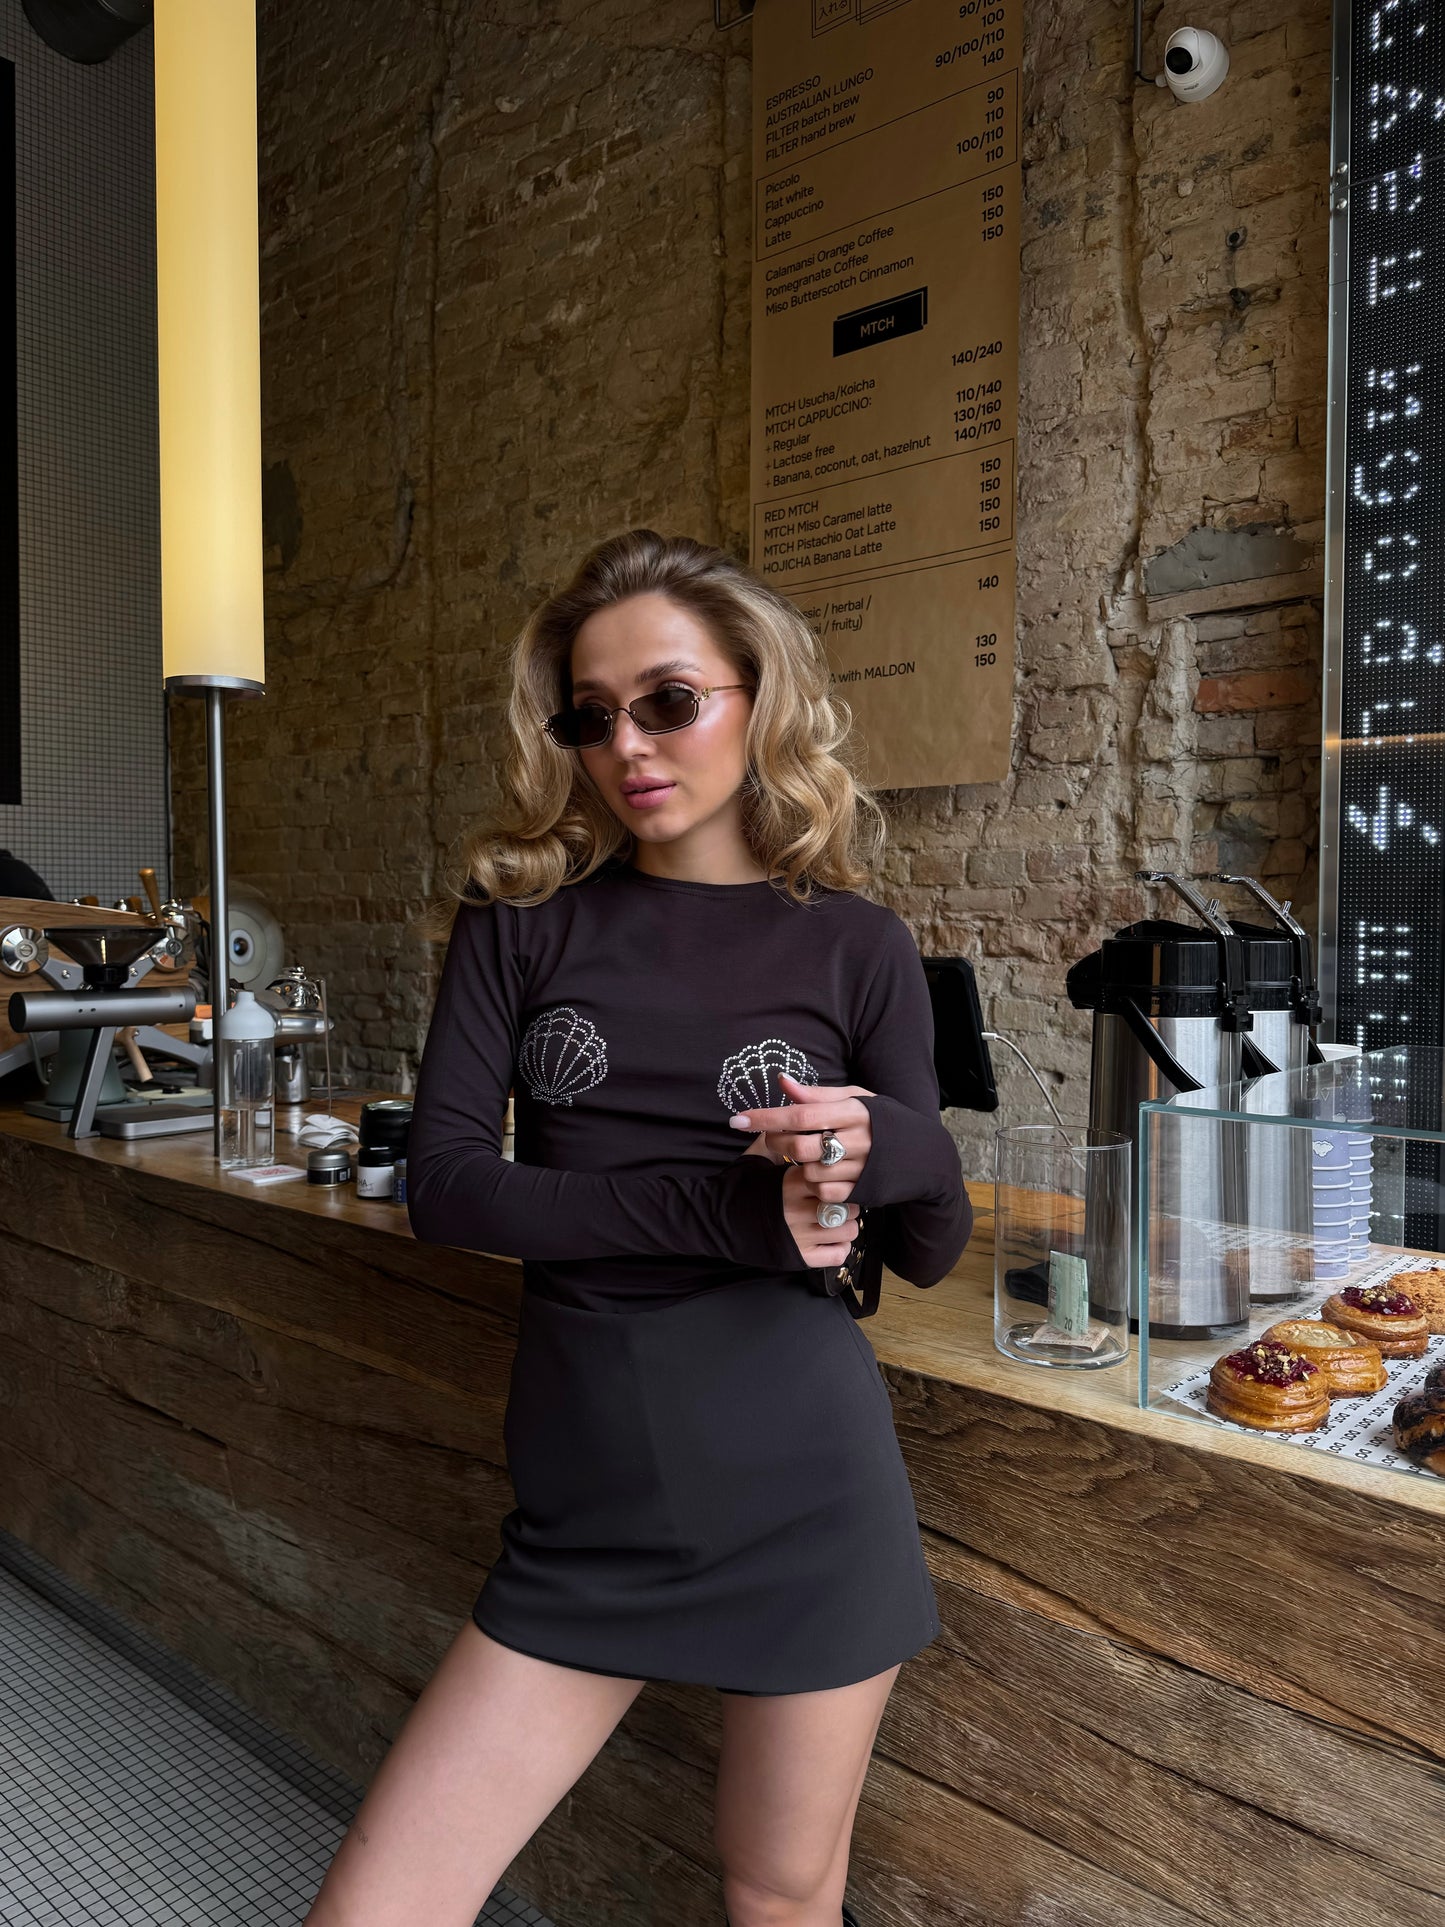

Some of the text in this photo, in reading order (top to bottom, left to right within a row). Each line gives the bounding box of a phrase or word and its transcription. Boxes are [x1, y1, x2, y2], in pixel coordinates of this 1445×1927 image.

[960, 0, 1003, 19] 90/10
[982, 8, 1004, 27] 100
[935, 28, 1004, 68] 90/100/110
[982, 48, 1004, 67] 140
[766, 75, 820, 110] ESPRESSO
[766, 68, 874, 128] AUSTRALIAN LUNGO
[987, 87, 1004, 104] 90
[766, 94, 860, 145] FILTER batch brew
[985, 106, 1004, 124] 110
[766, 114, 856, 162] FILTER hand brew
[956, 126, 1004, 155] 100/110
[985, 145, 1004, 163] 110
[765, 174, 800, 196] Piccolo
[982, 185, 1004, 203] 150
[765, 186, 814, 213] Flat white
[765, 200, 824, 230] Cappuccino
[982, 204, 1004, 222] 150
[765, 230, 792, 248] Latte
[982, 224, 1004, 242] 150
[765, 226, 894, 281] Calamansi Orange Coffee
[766, 254, 869, 299] Pomegranate Coffee
[766, 256, 914, 317] Miso Butterscotch Cinnamon
[860, 316, 895, 338] MTCH
[951, 341, 1003, 366] 140/240
[765, 378, 876, 420] MTCH Usucha/Koicha
[956, 380, 1002, 403] 110/140
[765, 396, 872, 437] MTCH CAPPUCCINO:
[954, 399, 1002, 423] 130/160
[954, 418, 1001, 442] 140/170
[815, 444, 835, 458] free
[815, 455, 859, 476] coconut,
[861, 450, 882, 464] oat,
[883, 435, 931, 458] hazelnut
[980, 458, 1001, 474] 150
[980, 477, 1001, 493] 150
[764, 500, 819, 523] RED MTCH
[979, 497, 1000, 512] 150
[764, 502, 893, 541] MTCH Miso Caramel latte
[979, 516, 1000, 532] 150
[763, 520, 897, 557] MTCH Pistachio Oat Latte
[763, 541, 883, 575] HOJICHA Banana Latte
[977, 575, 999, 591] 140
[800, 606, 821, 620] ssic
[832, 597, 864, 615] herbal
[832, 614, 863, 632] fruity)
[975, 633, 997, 648] 130
[974, 652, 996, 667] 150
[838, 670, 861, 683] with
[864, 661, 915, 679] MALDON
